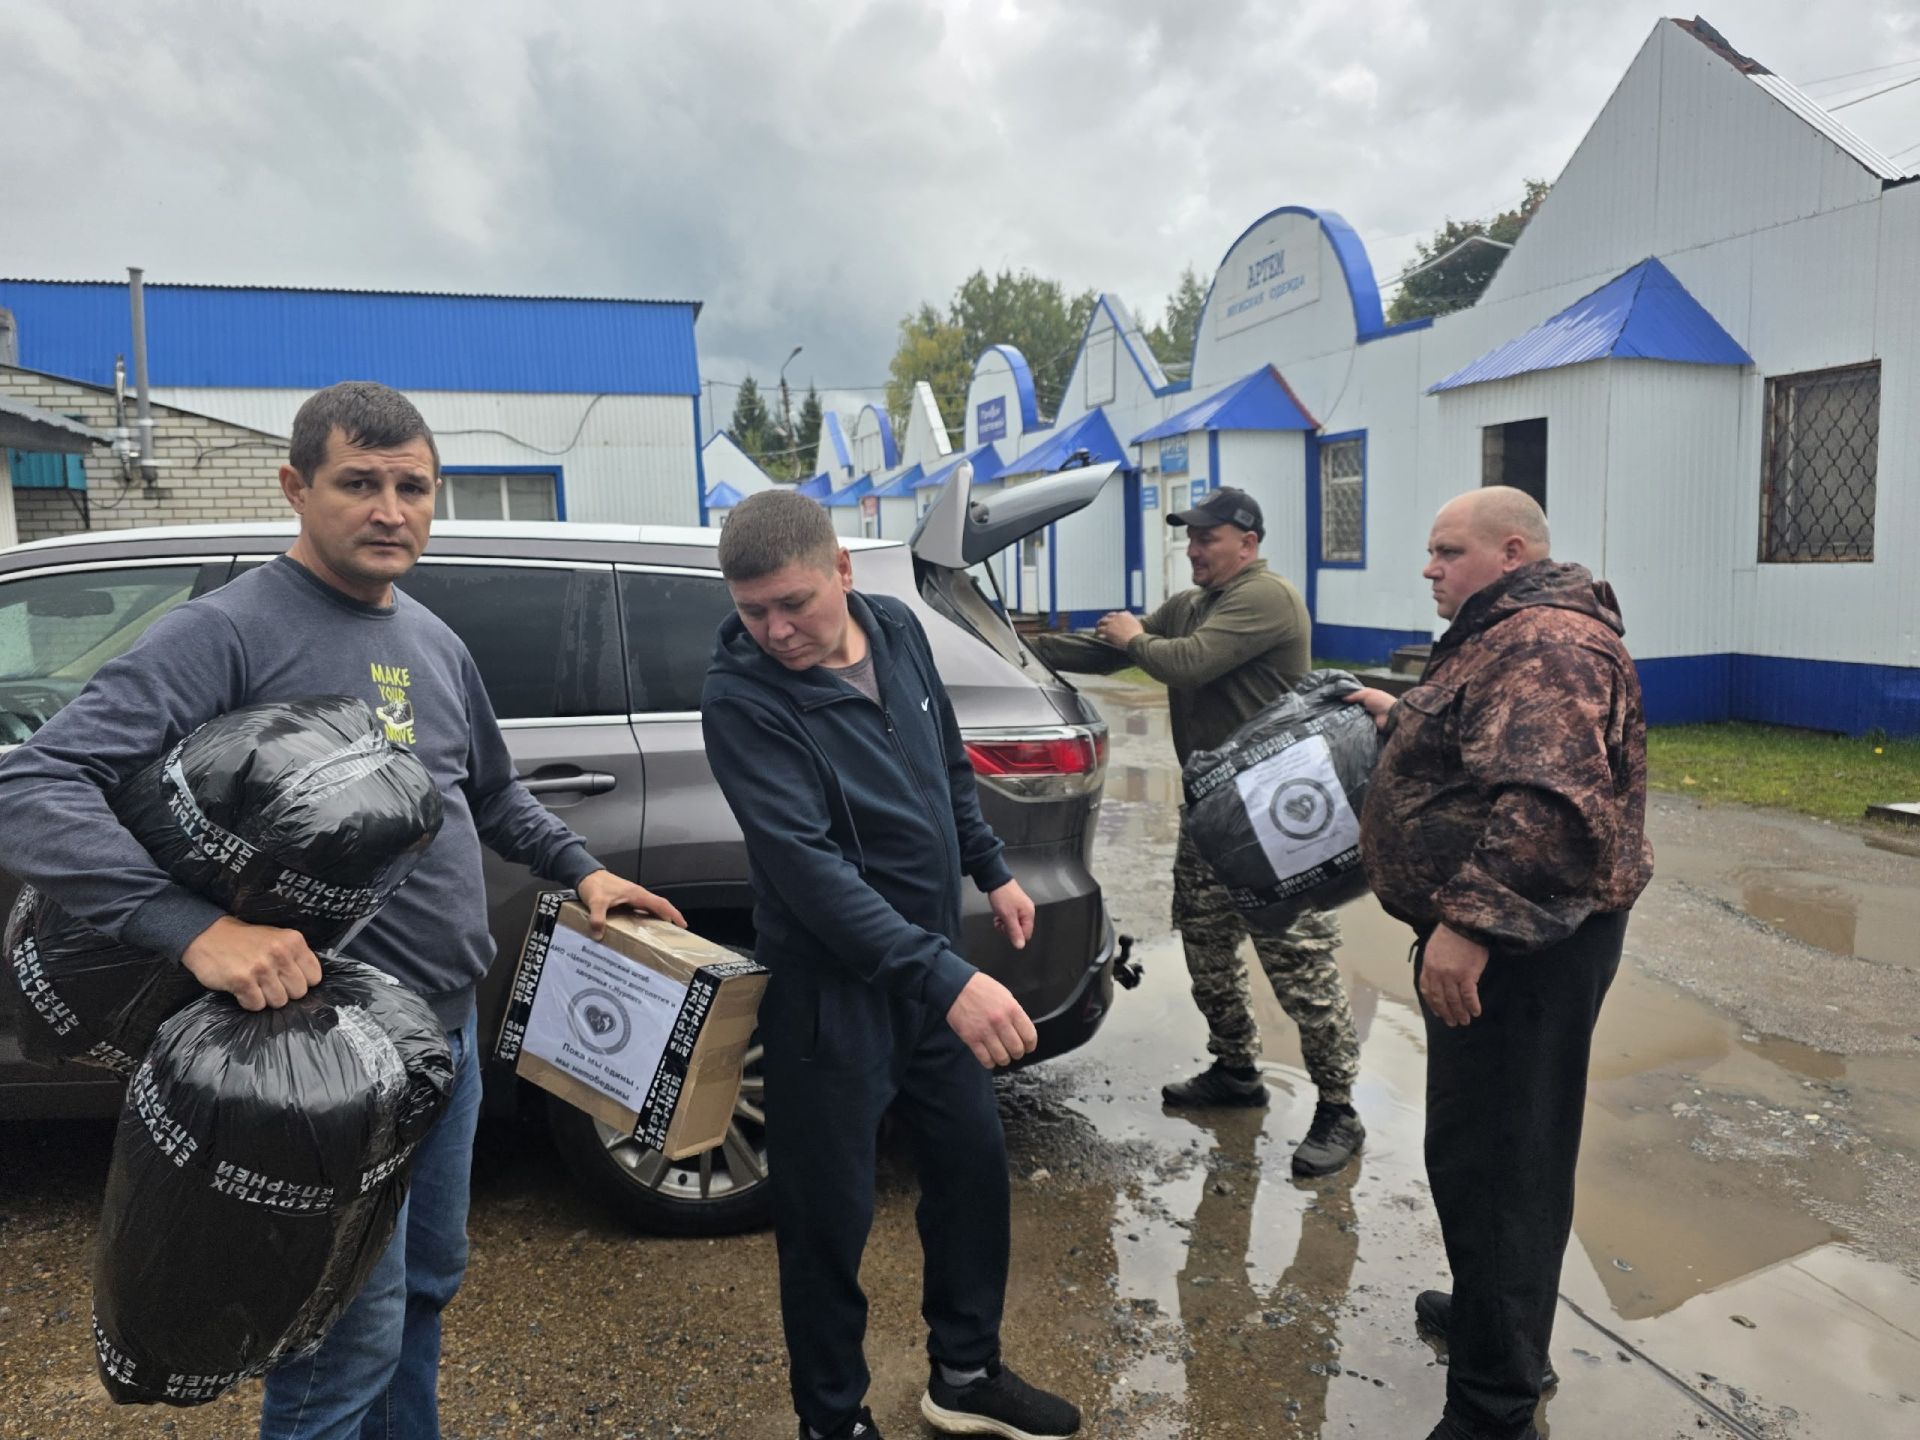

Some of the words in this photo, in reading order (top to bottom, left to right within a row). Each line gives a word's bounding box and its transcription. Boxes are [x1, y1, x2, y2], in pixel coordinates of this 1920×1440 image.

[370, 662, 411, 687] MAKE
[378, 684, 406, 703] YOUR
[229, 847, 253, 874] ДЛЯ
[12, 944, 57, 1024] КРУТЫХ
[522, 944, 547, 1006] КРУТЫХ
[54, 1014, 80, 1037] ДЛЯ
[674, 979, 704, 1040] КРУТЫХ
[554, 1056, 570, 1069] мы
[562, 1042, 586, 1061] Пока
[587, 1056, 602, 1069] мы
[603, 1066, 635, 1087] едины
[649, 1072, 673, 1135] КРУТЫХ
[173, 1136, 199, 1168] ДЛЯ
[209, 1175, 312, 1210] КРУТЫХ
